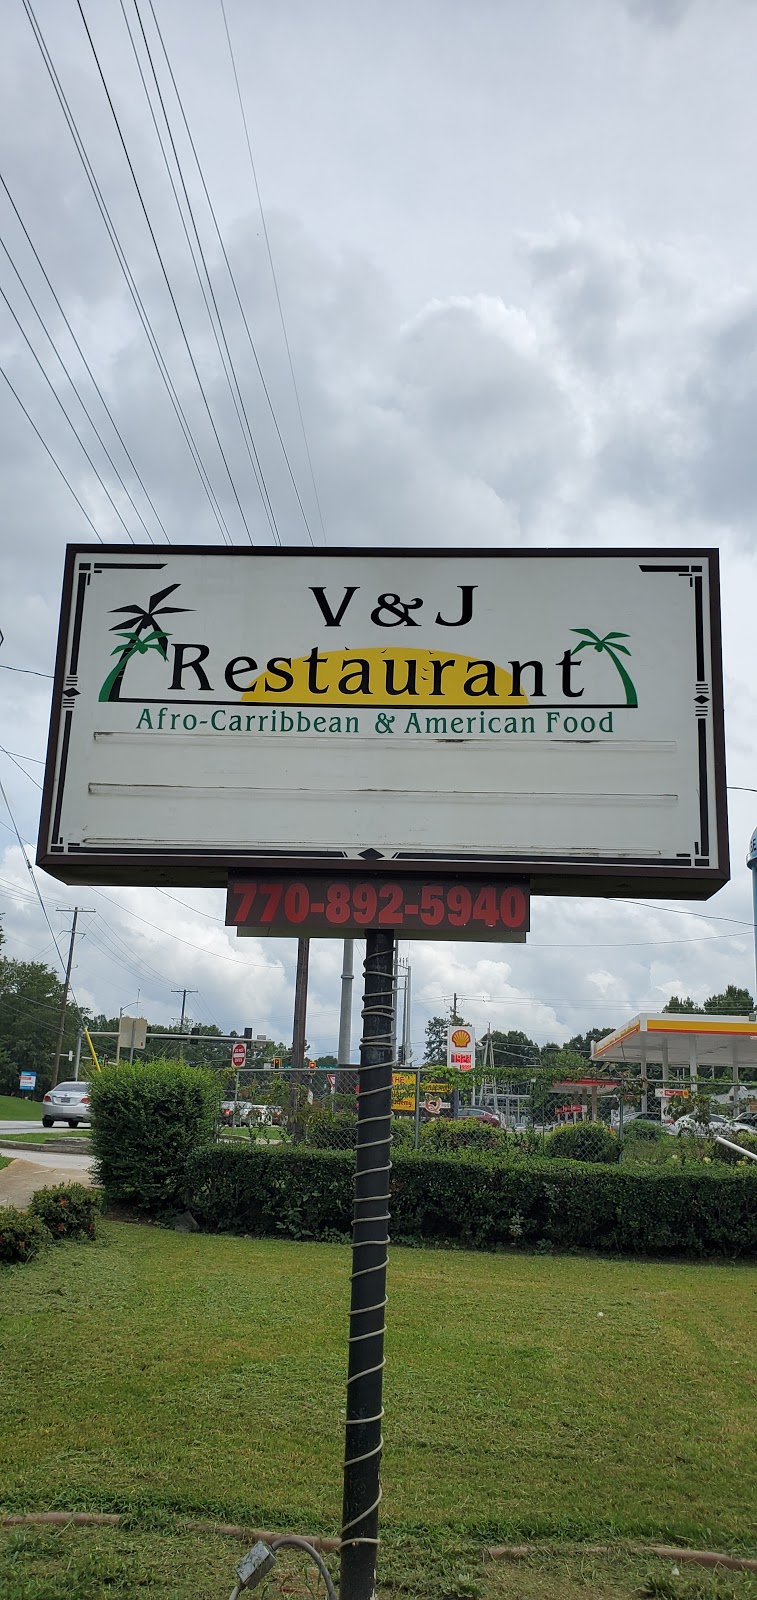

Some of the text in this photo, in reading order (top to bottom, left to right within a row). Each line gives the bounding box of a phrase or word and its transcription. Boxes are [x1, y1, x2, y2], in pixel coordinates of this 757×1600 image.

[308, 585, 479, 628] V & J
[167, 645, 585, 697] Restaurant
[136, 707, 614, 735] Afro-Carribbean & American Food
[233, 883, 526, 927] 770-892-5940
